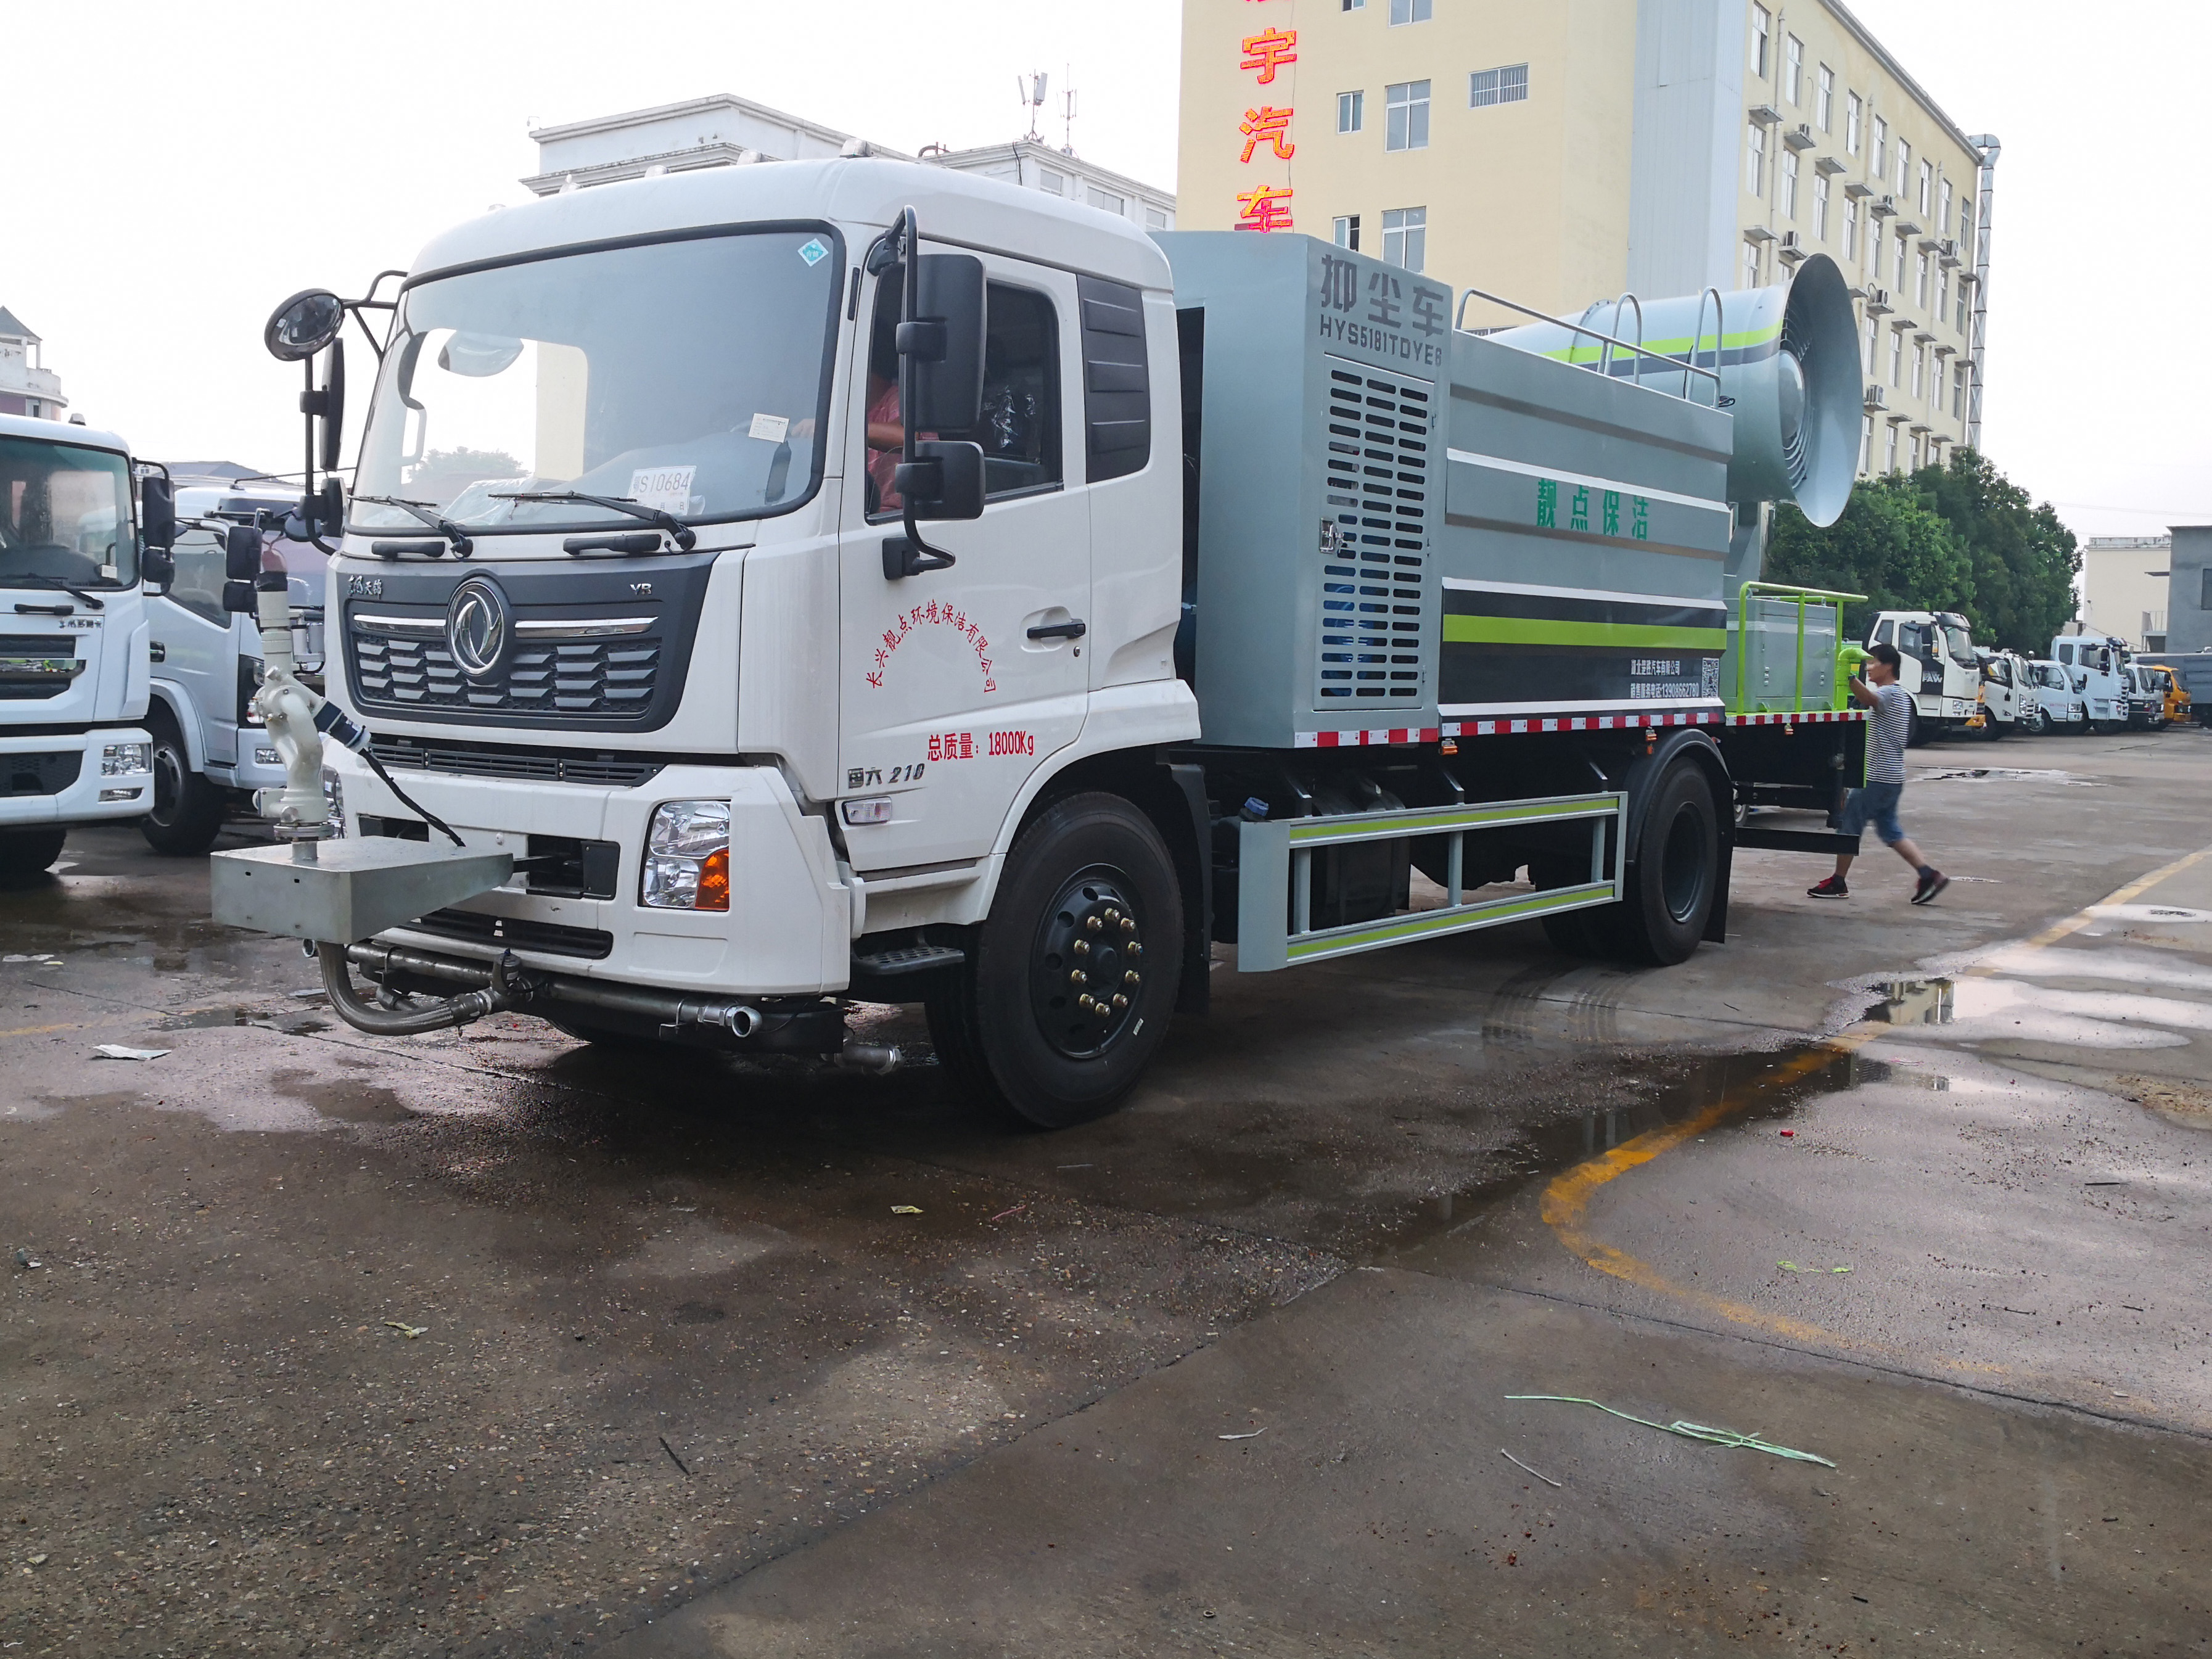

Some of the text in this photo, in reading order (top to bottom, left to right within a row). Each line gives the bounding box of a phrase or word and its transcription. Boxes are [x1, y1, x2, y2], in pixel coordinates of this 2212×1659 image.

[1234, 0, 1297, 233] 宇汽车
[1320, 253, 1444, 337] 抑尘车
[1536, 477, 1649, 541] 靓点保洁
[630, 583, 652, 595] VR
[865, 598, 997, 693] 长兴靓点环境保洁有限公司
[1922, 670, 1943, 683] FAW
[887, 762, 926, 784] 210
